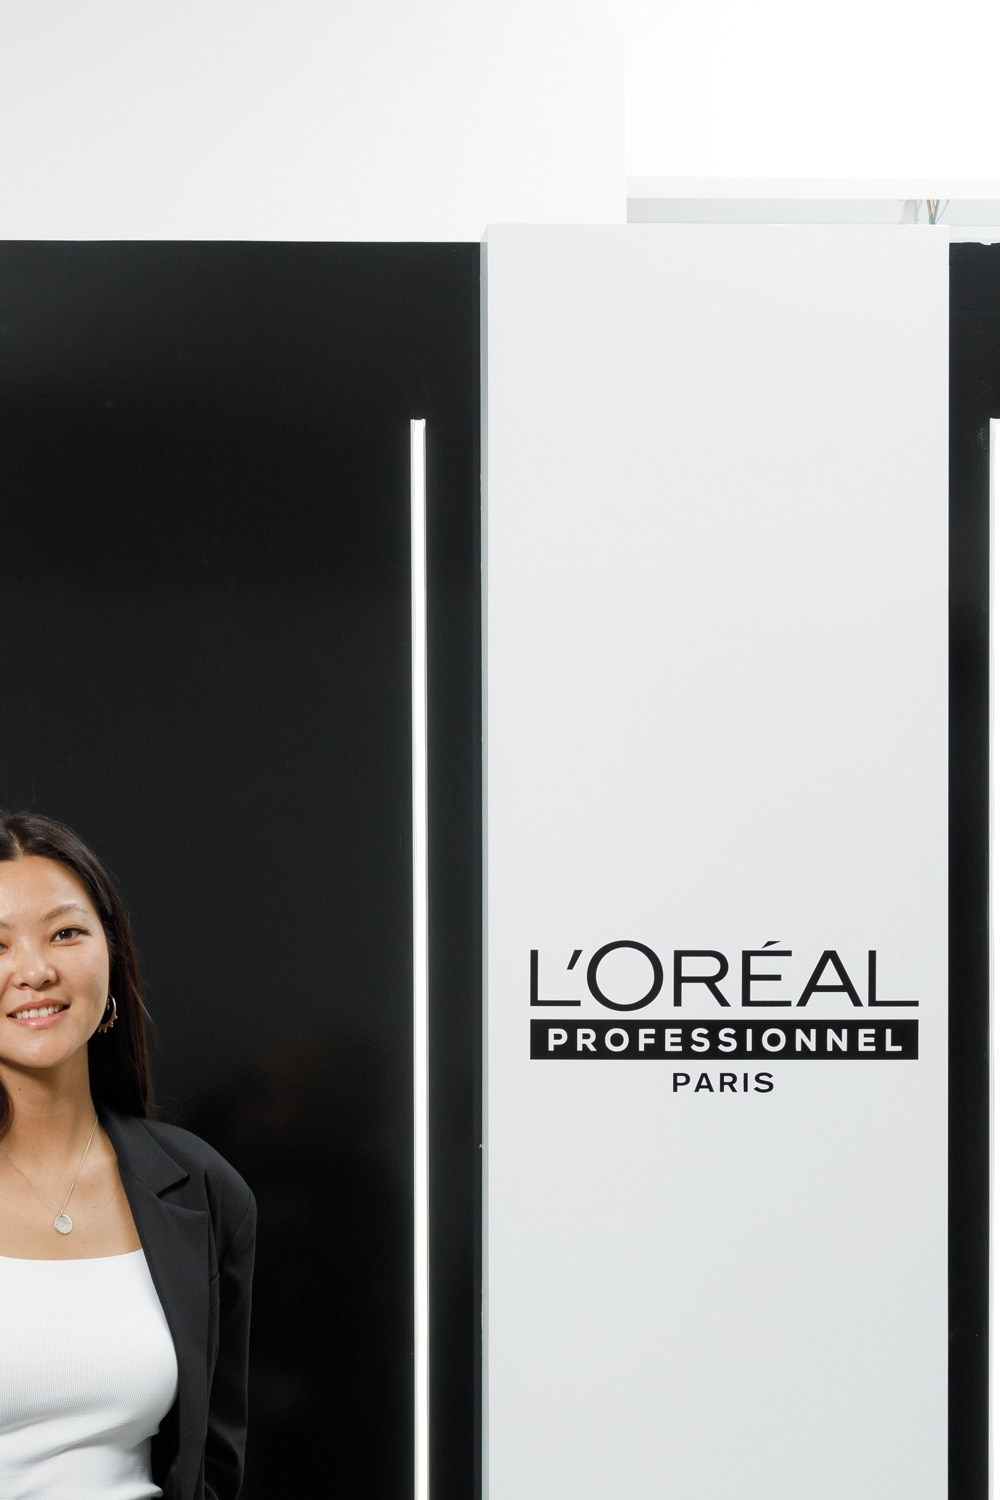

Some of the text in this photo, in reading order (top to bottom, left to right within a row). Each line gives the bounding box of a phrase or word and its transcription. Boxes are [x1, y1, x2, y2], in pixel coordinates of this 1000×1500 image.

[529, 940, 920, 1012] L'ORÉAL
[547, 1027, 904, 1053] PROFESSIONNEL
[672, 1072, 775, 1094] PARIS
